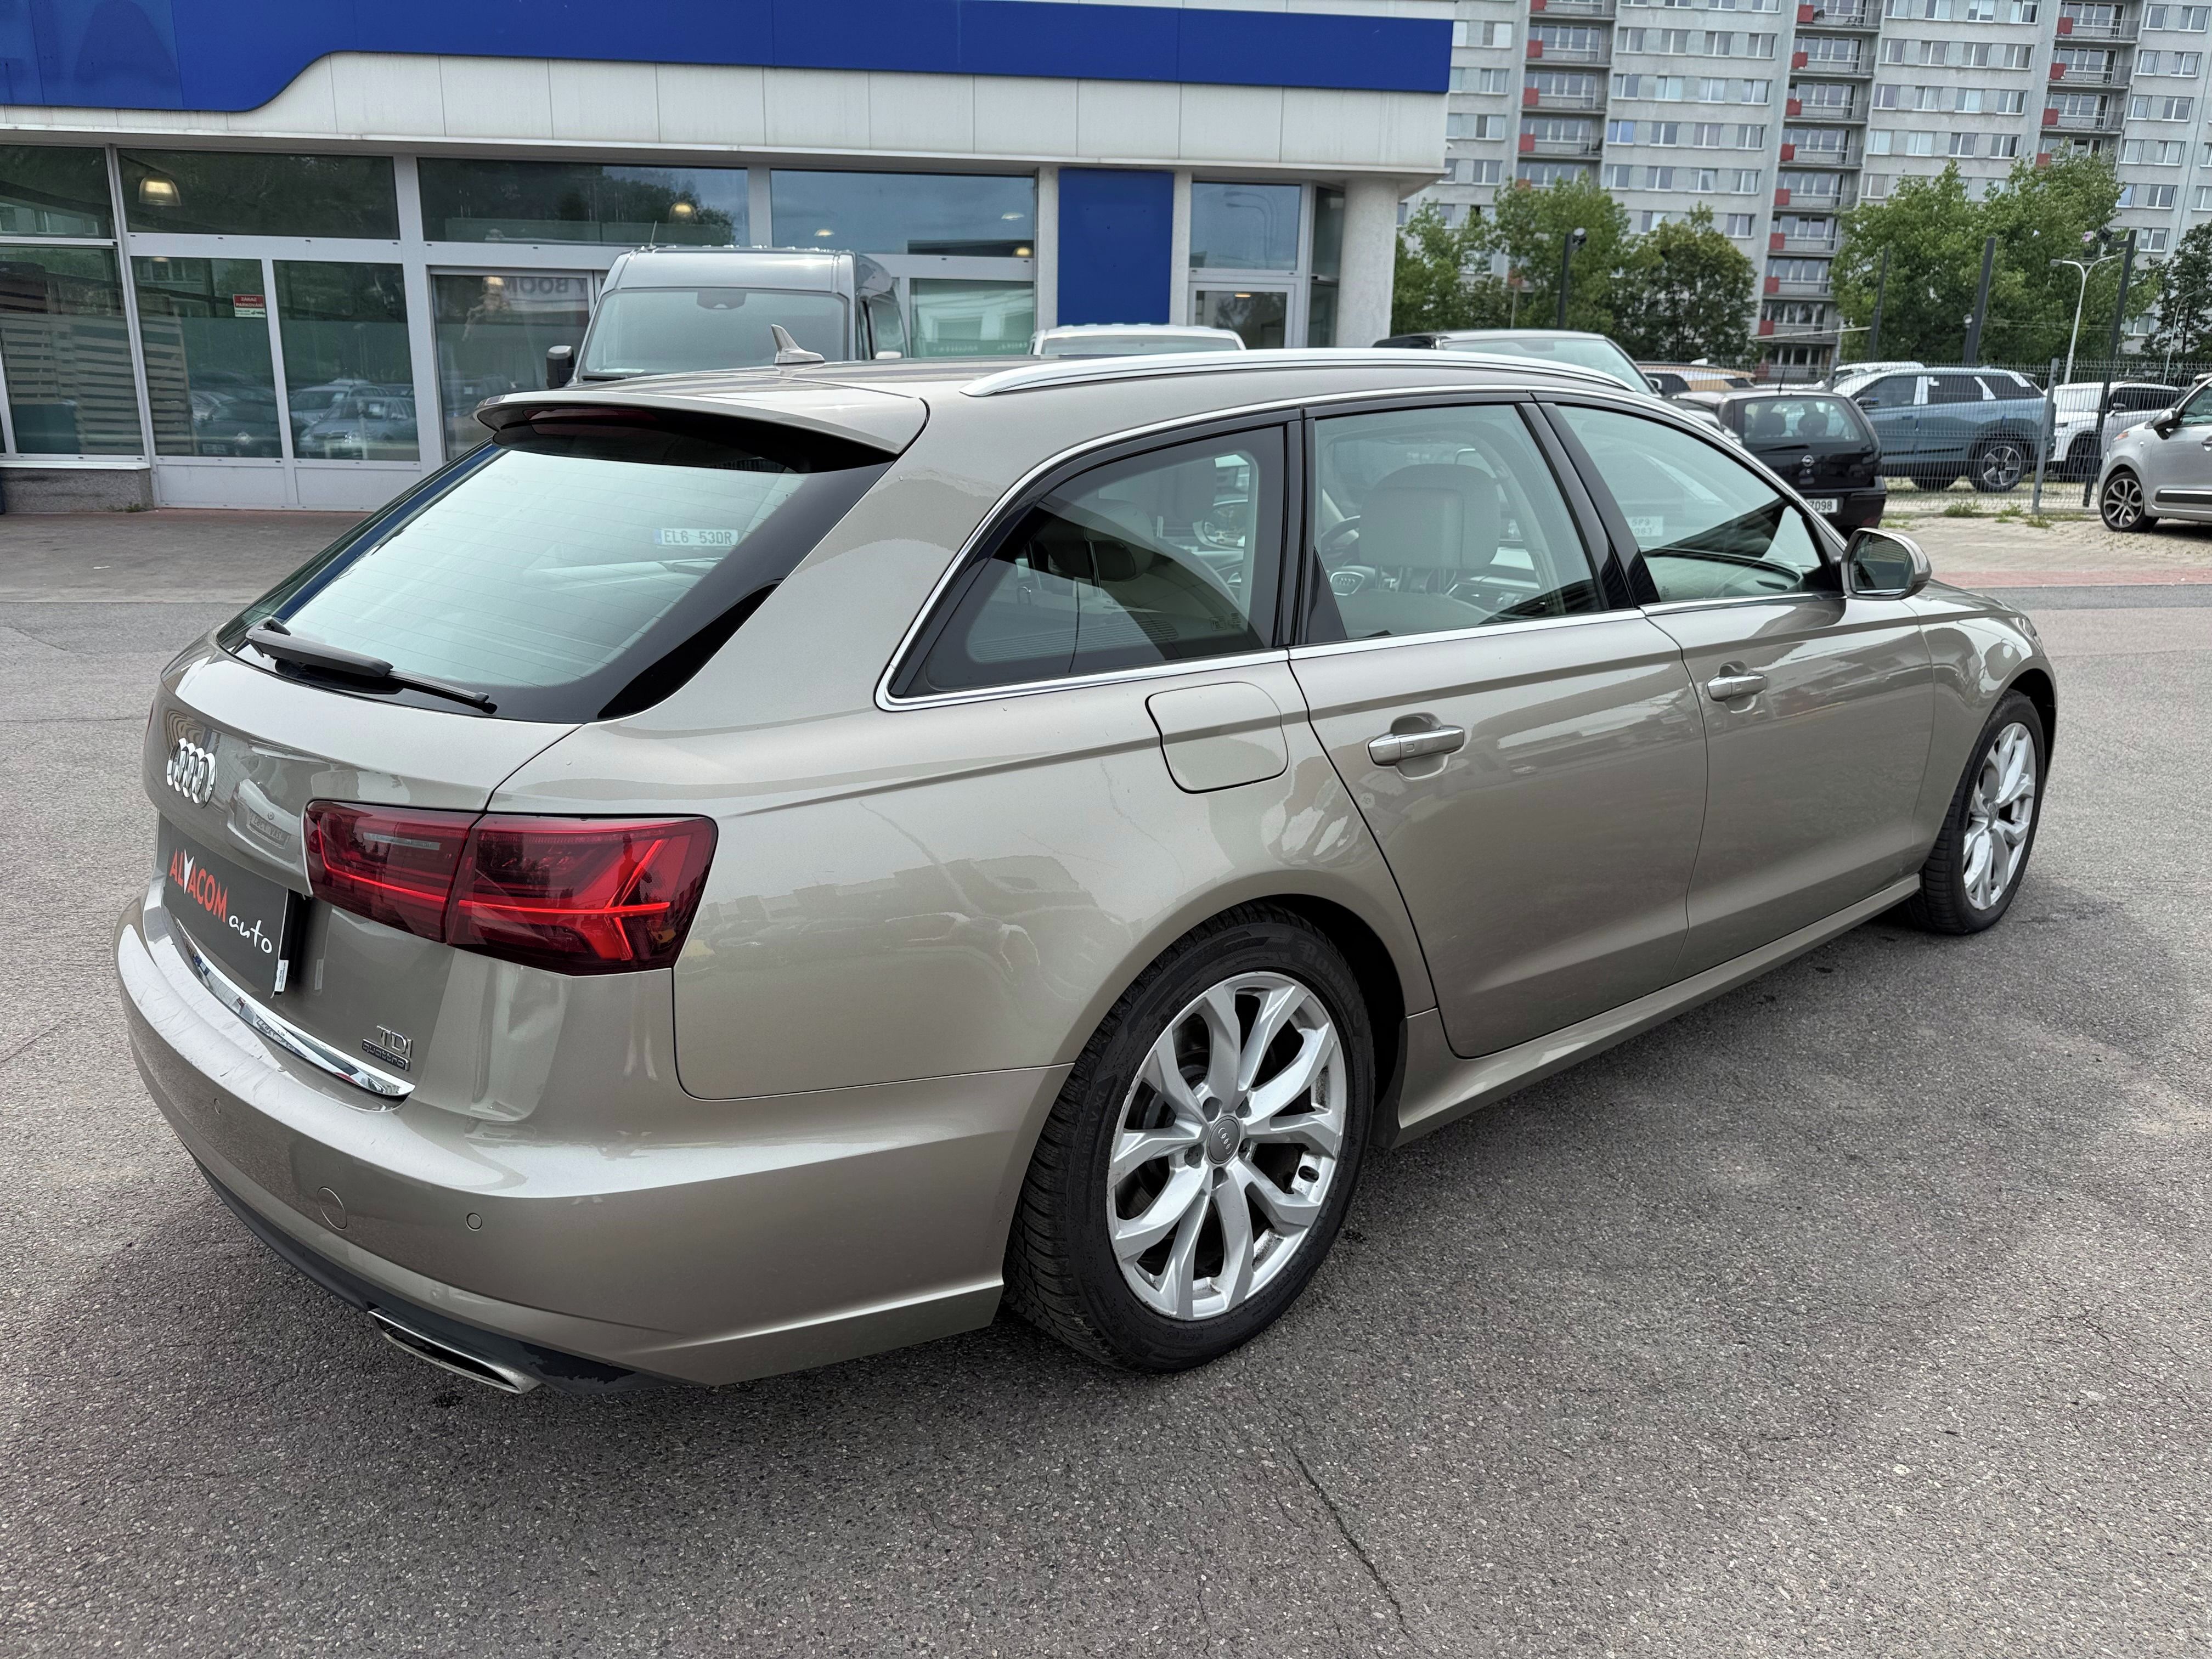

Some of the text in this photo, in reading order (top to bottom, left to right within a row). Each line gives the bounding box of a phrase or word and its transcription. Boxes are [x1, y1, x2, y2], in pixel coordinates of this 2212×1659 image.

[664, 531, 689, 543] EL6
[229, 916, 273, 953] auto
[363, 1042, 405, 1068] quattro
[376, 1025, 413, 1058] TDI
